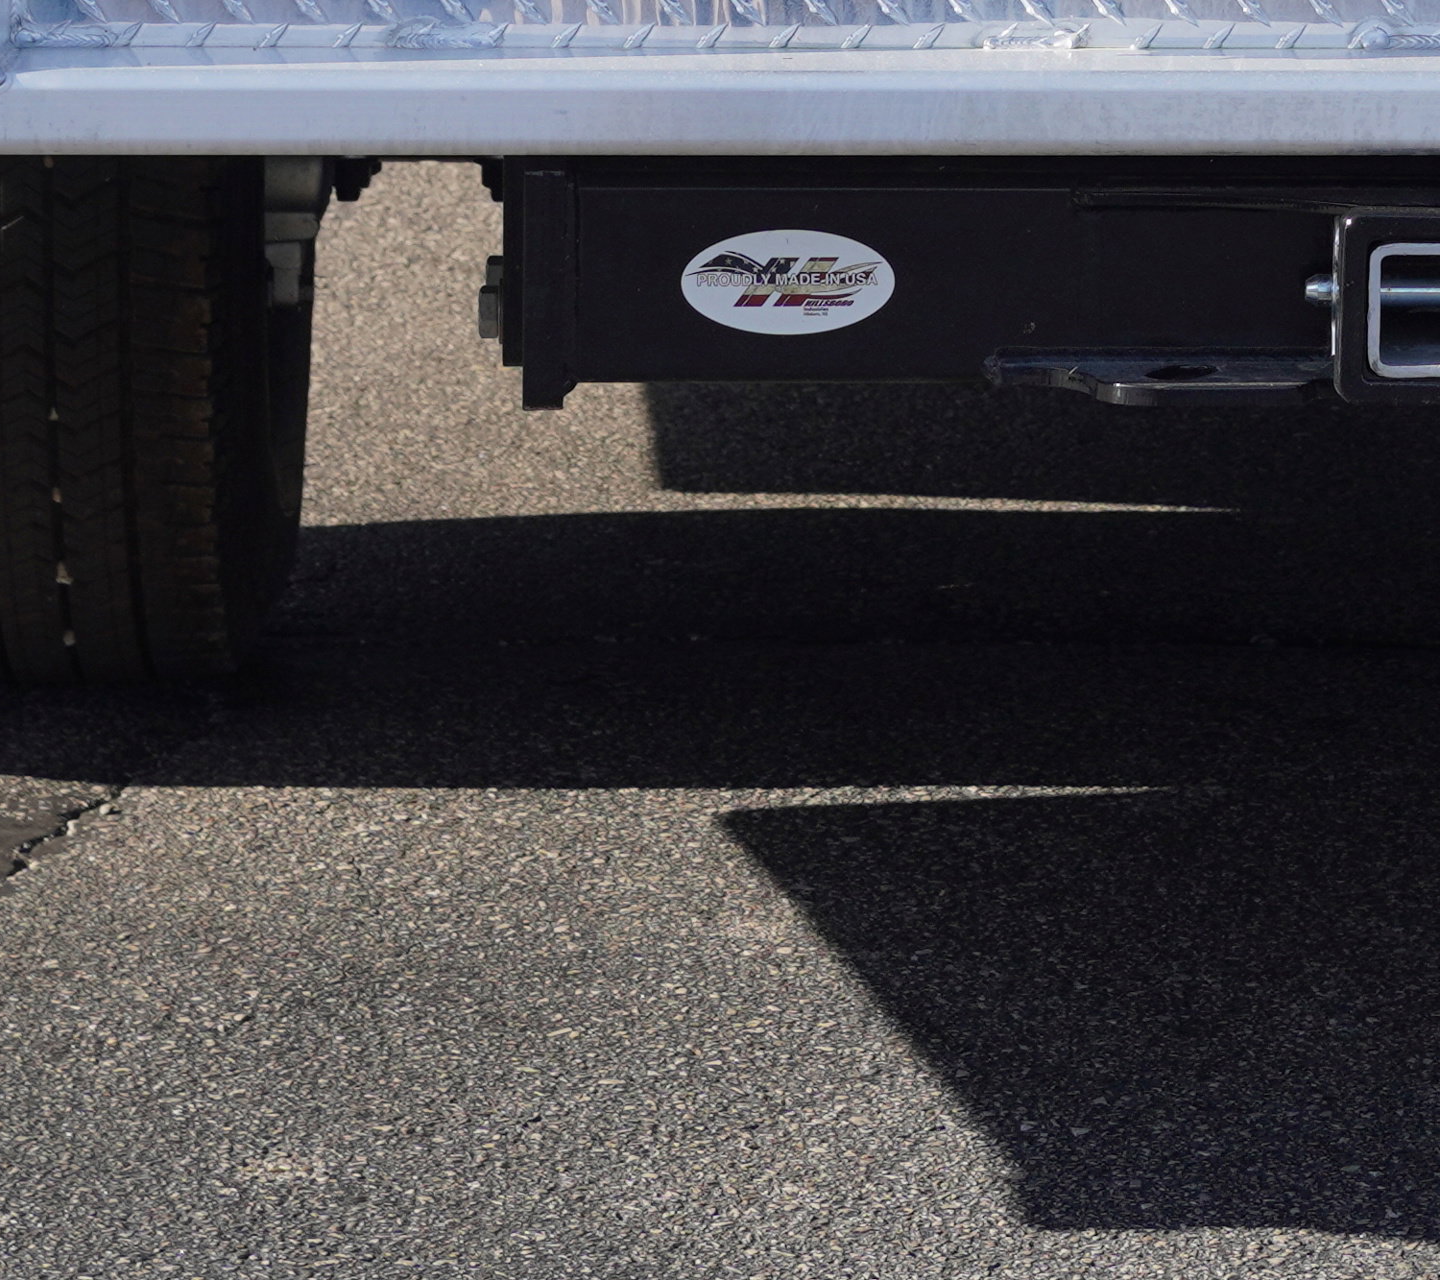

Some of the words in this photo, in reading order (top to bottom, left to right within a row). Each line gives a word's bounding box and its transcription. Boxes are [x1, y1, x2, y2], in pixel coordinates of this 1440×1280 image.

[696, 272, 771, 287] PROUDLY
[775, 272, 819, 286] MADE
[825, 272, 841, 286] IN
[845, 272, 878, 286] USA
